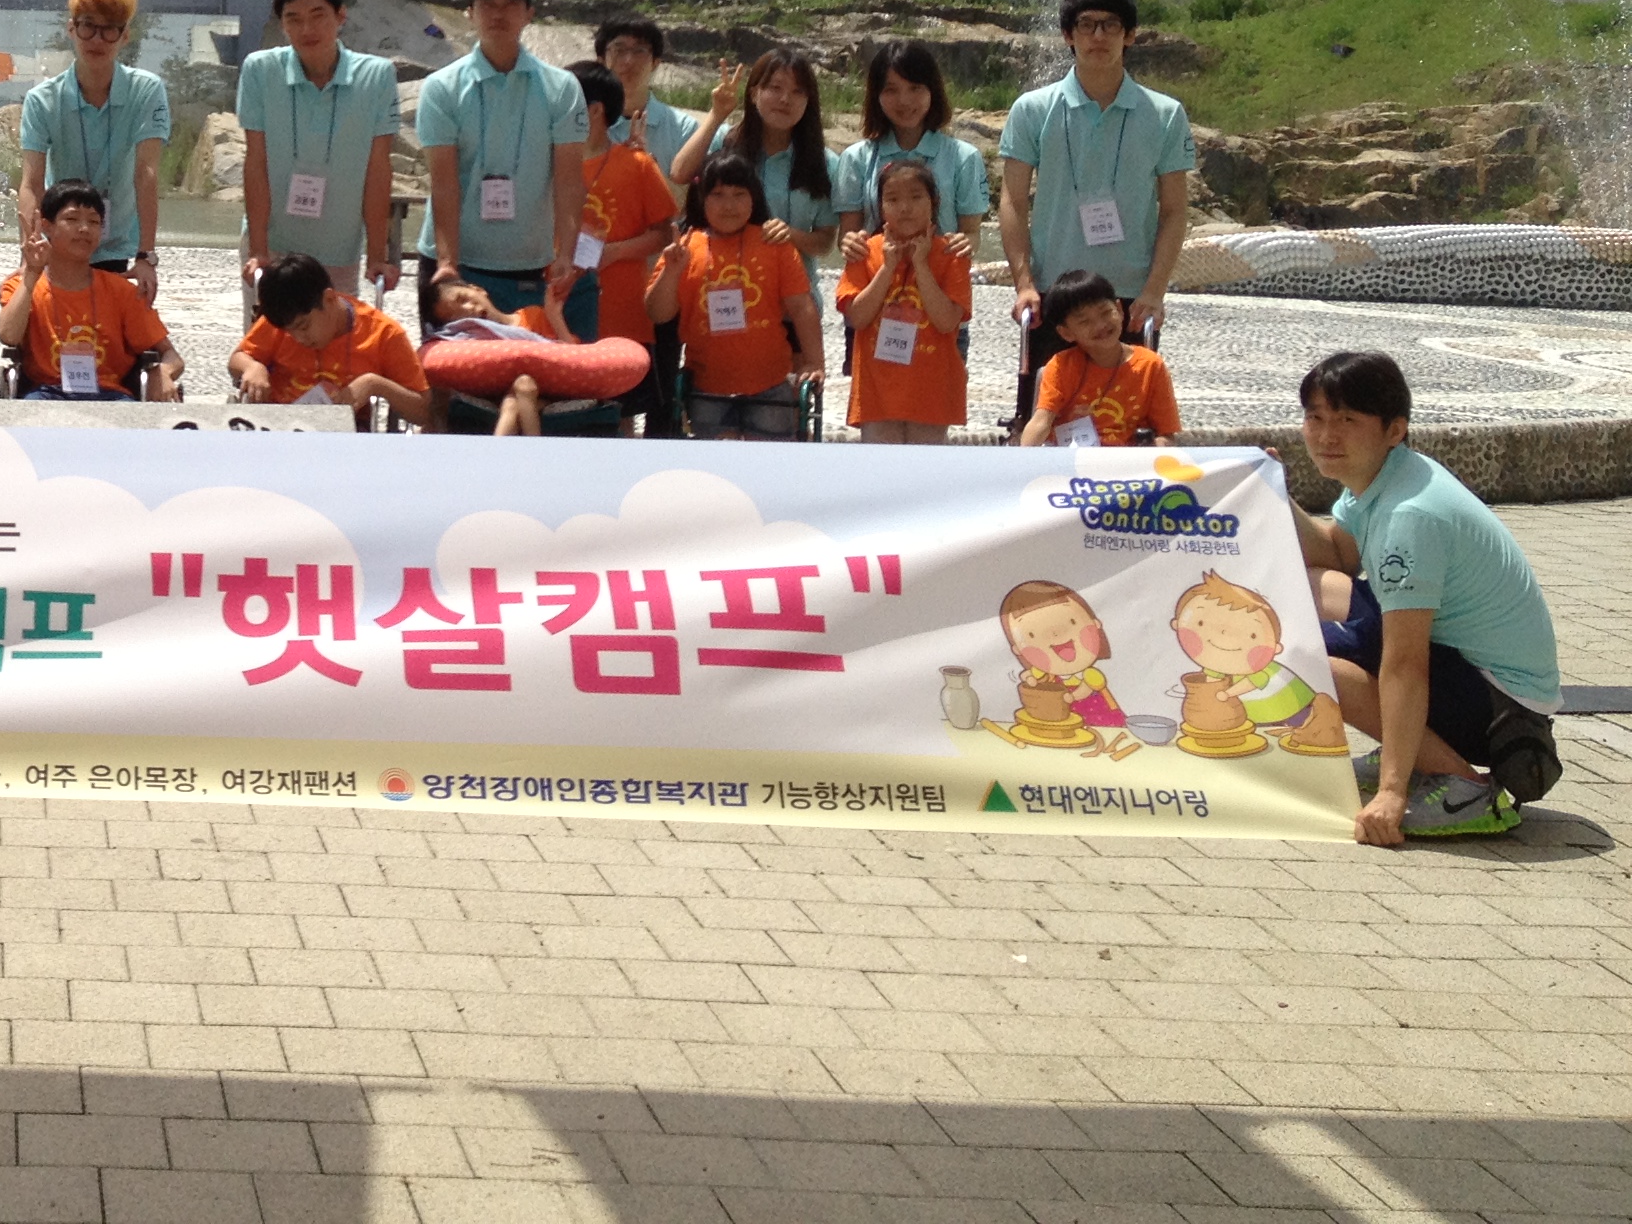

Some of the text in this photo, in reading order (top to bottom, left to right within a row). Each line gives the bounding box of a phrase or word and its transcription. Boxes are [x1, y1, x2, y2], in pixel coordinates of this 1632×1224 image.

[1052, 493, 1145, 509] Energy
[1085, 507, 1233, 531] Contributor
[1084, 533, 1240, 555] 현대엔지니어링 사회공헌팀
[25, 764, 77, 789] 여주
[88, 765, 208, 795] 은아목장,
[422, 774, 749, 807] 양천장애인종합복지관
[762, 782, 946, 813] 기능향상지원팀
[1019, 784, 1209, 818] 현대엔지니어링
